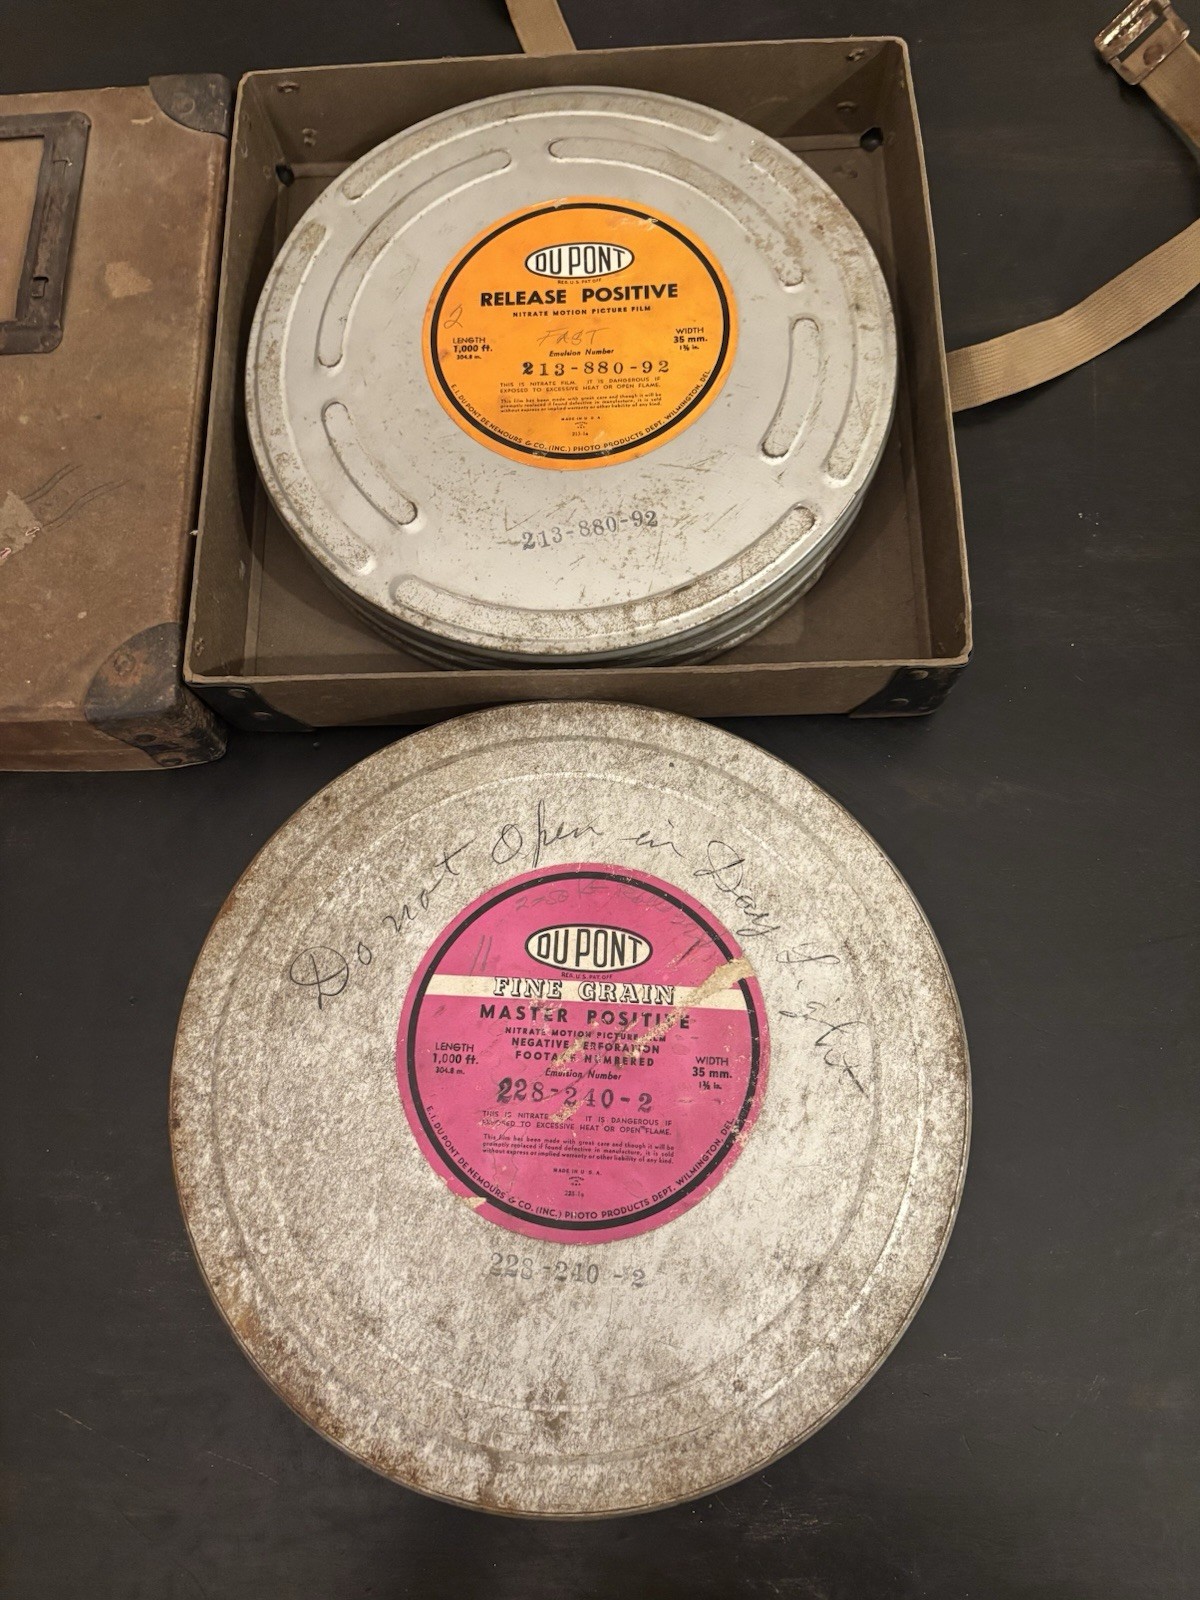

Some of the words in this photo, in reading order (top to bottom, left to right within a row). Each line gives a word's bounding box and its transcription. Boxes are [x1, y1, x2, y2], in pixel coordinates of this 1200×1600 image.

[480, 289, 567, 307] RELEASE
[581, 283, 678, 303] POSITIVE
[512, 310, 549, 318] NITRATE
[591, 306, 628, 314] PICTURE
[673, 335, 685, 343] 35
[687, 335, 708, 343] mm.
[453, 344, 479, 354] 1,000
[481, 344, 493, 352] ft.
[549, 350, 581, 358] Emulsion
[585, 348, 615, 356] Number
[480, 417, 490, 426] DE
[488, 423, 522, 444] NEMOURS
[533, 442, 547, 450] CO.
[573, 444, 601, 452] PHOTO
[603, 430, 644, 449] PRODUCTS
[644, 419, 665, 434] DEPT.
[522, 510, 658, 551] 213-880-92
[289, 941, 372, 1010] Do
[493, 976, 563, 1000] FINE
[577, 980, 676, 1006] GRAIN
[479, 1004, 568, 1023] MASTER
[505, 1026, 546, 1036] NITRATE
[551, 1029, 592, 1038] MOTION
[435, 1042, 475, 1053] LENGTH
[511, 1037, 570, 1049] NEGATIVE
[432, 1052, 462, 1065] 1,000
[465, 1053, 479, 1065] ft.
[695, 1056, 729, 1066] WIDTH
[435, 1066, 455, 1074] 304.8
[587, 1070, 622, 1081] Number
[692, 1066, 705, 1077] 35
[708, 1069, 733, 1079] mm.
[482, 1110, 499, 1118] THIS
[517, 1112, 549, 1120] NITRATE
[611, 1117, 659, 1126] DANGEROUS
[536, 1121, 575, 1130] EXCESSIVE
[579, 1124, 599, 1132] HEAT
[619, 1126, 641, 1134] OPEN
[645, 1127, 672, 1136] FLAME.
[426, 1105, 434, 1115] E.
[430, 1114, 436, 1122] I.
[457, 1157, 469, 1169] DE
[467, 1166, 506, 1199] NEMOURS
[508, 1196, 516, 1204] &
[517, 1200, 534, 1212] CO.
[535, 1206, 562, 1218] (INC.)
[564, 1211, 598, 1219] PHOTO
[601, 1198, 650, 1219] PRODUCTS
[651, 1185, 676, 1202] DEPT.
[675, 1138, 724, 1186] WILMINGTON,
